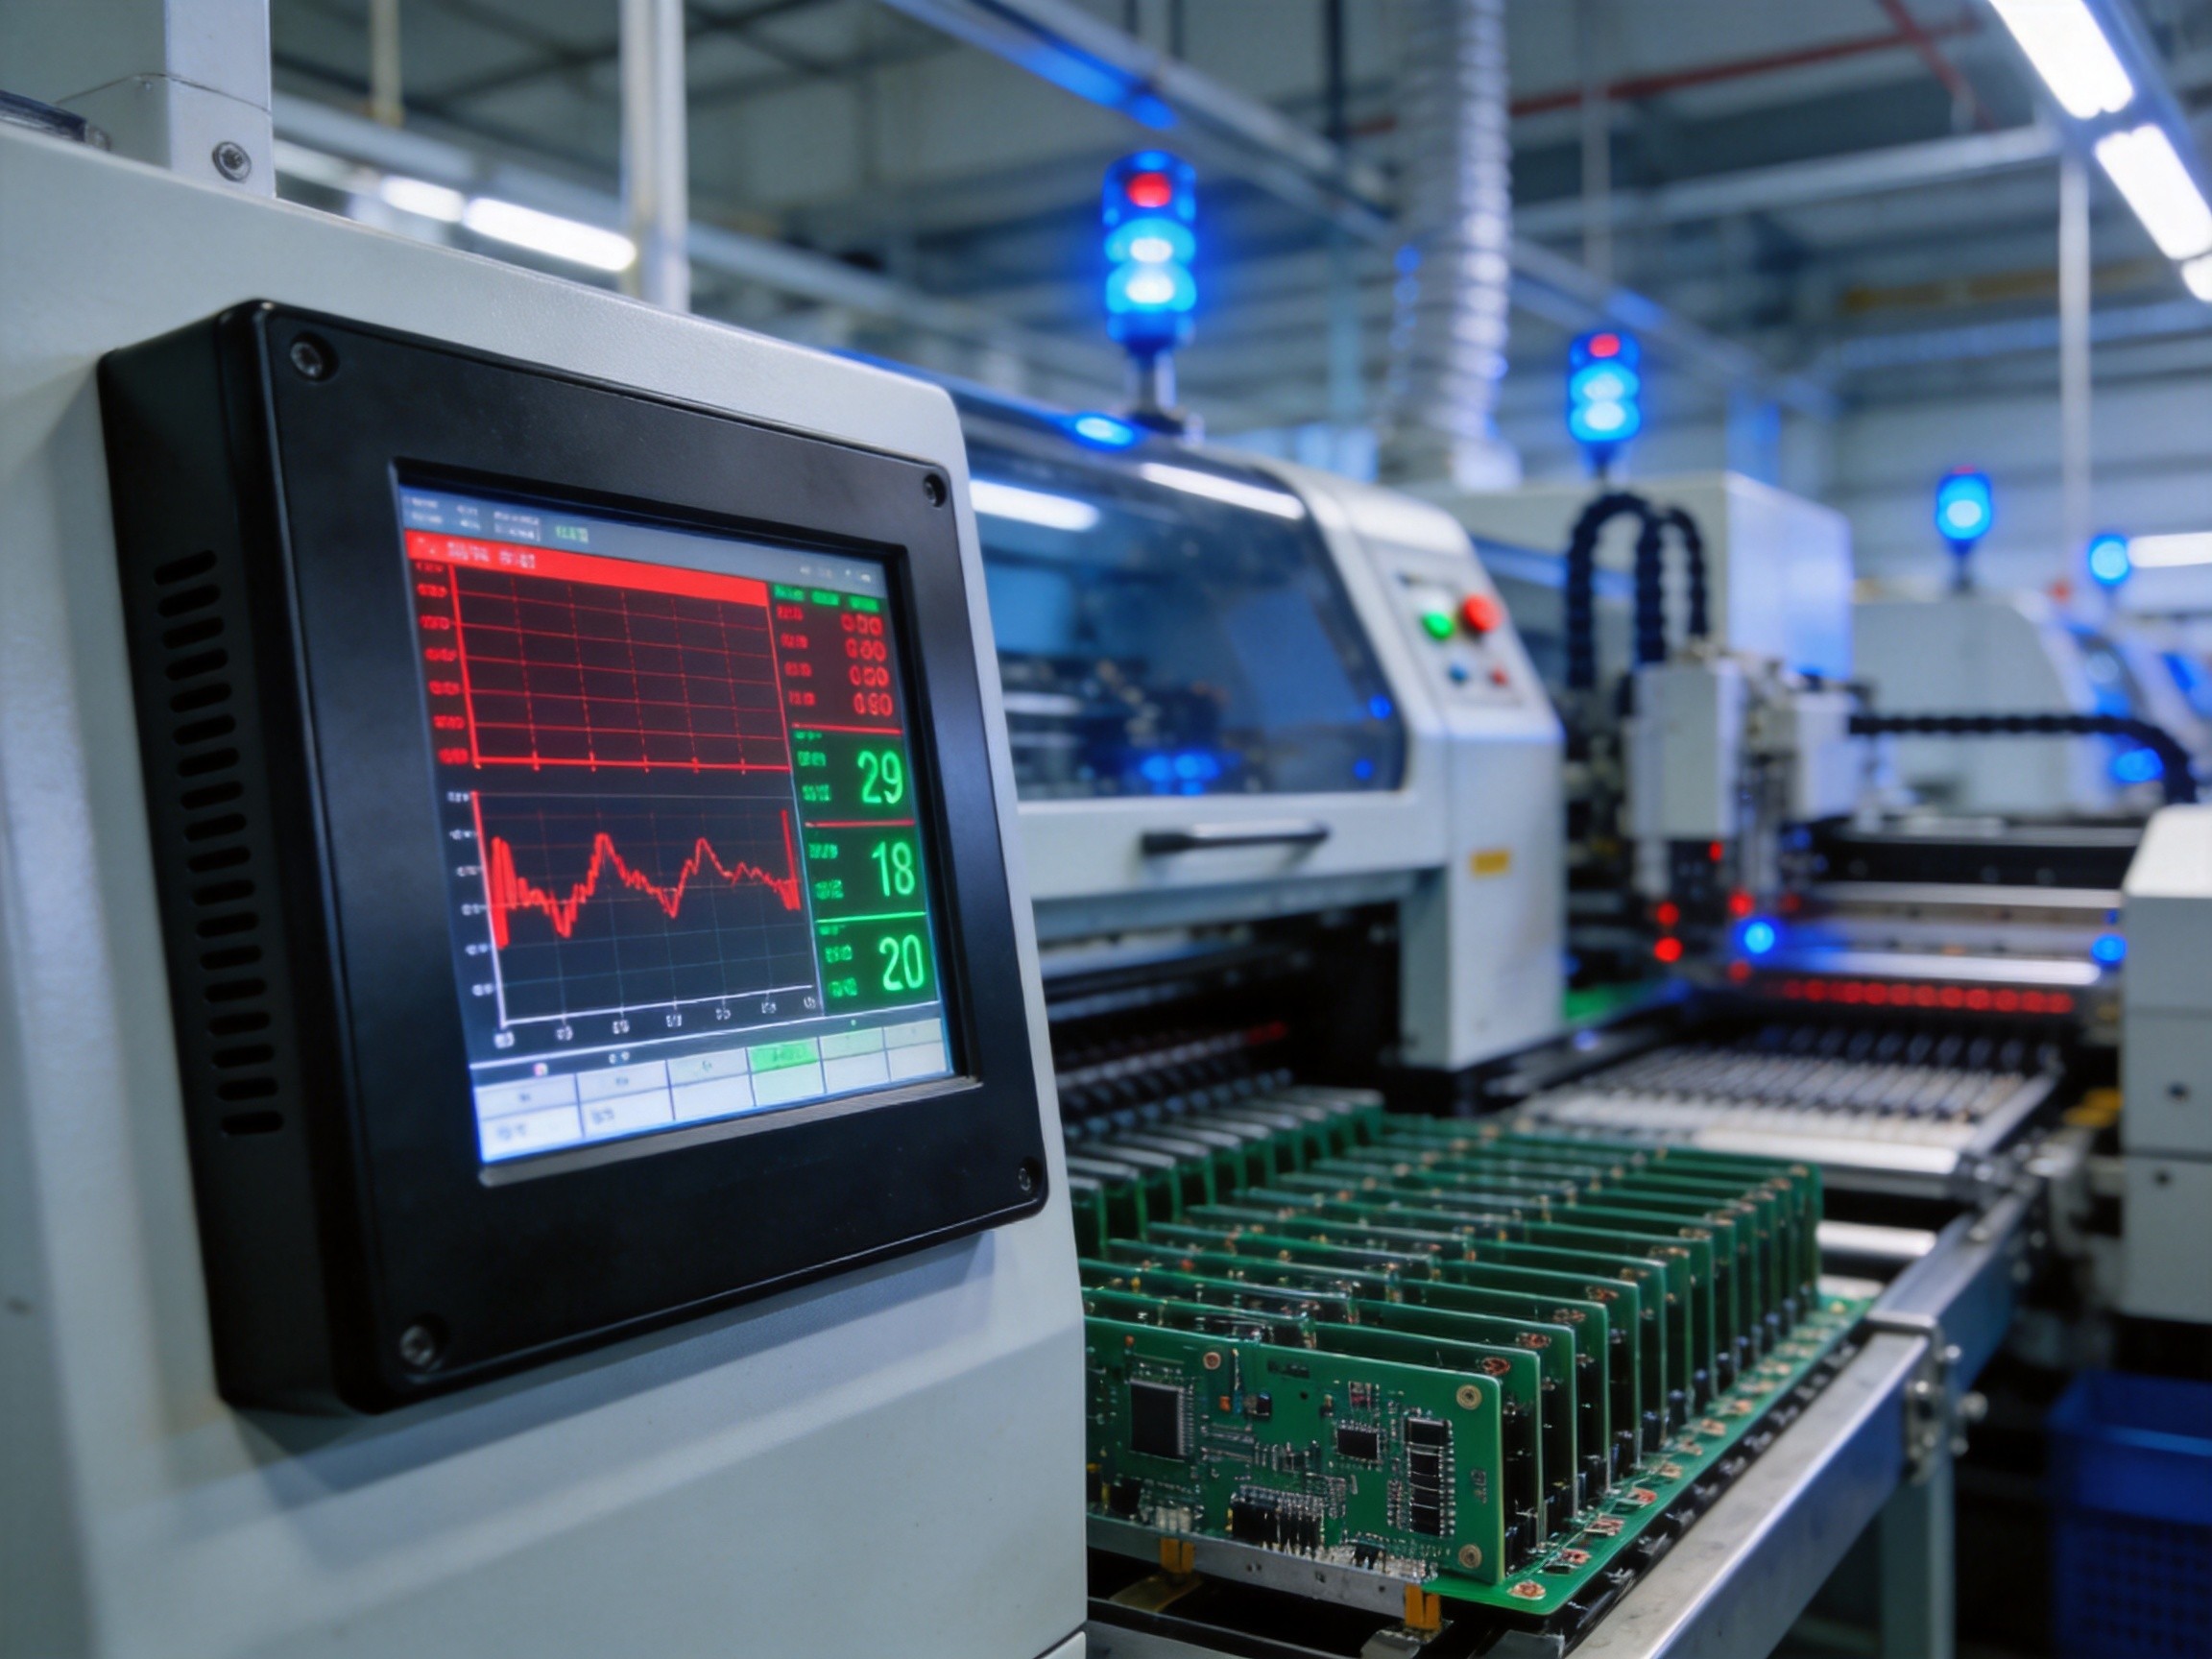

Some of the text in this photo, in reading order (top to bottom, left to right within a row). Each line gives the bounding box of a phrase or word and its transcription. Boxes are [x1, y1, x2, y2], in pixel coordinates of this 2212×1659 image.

[857, 750, 903, 804] 29
[872, 841, 915, 897] 18
[878, 934, 924, 991] 20
